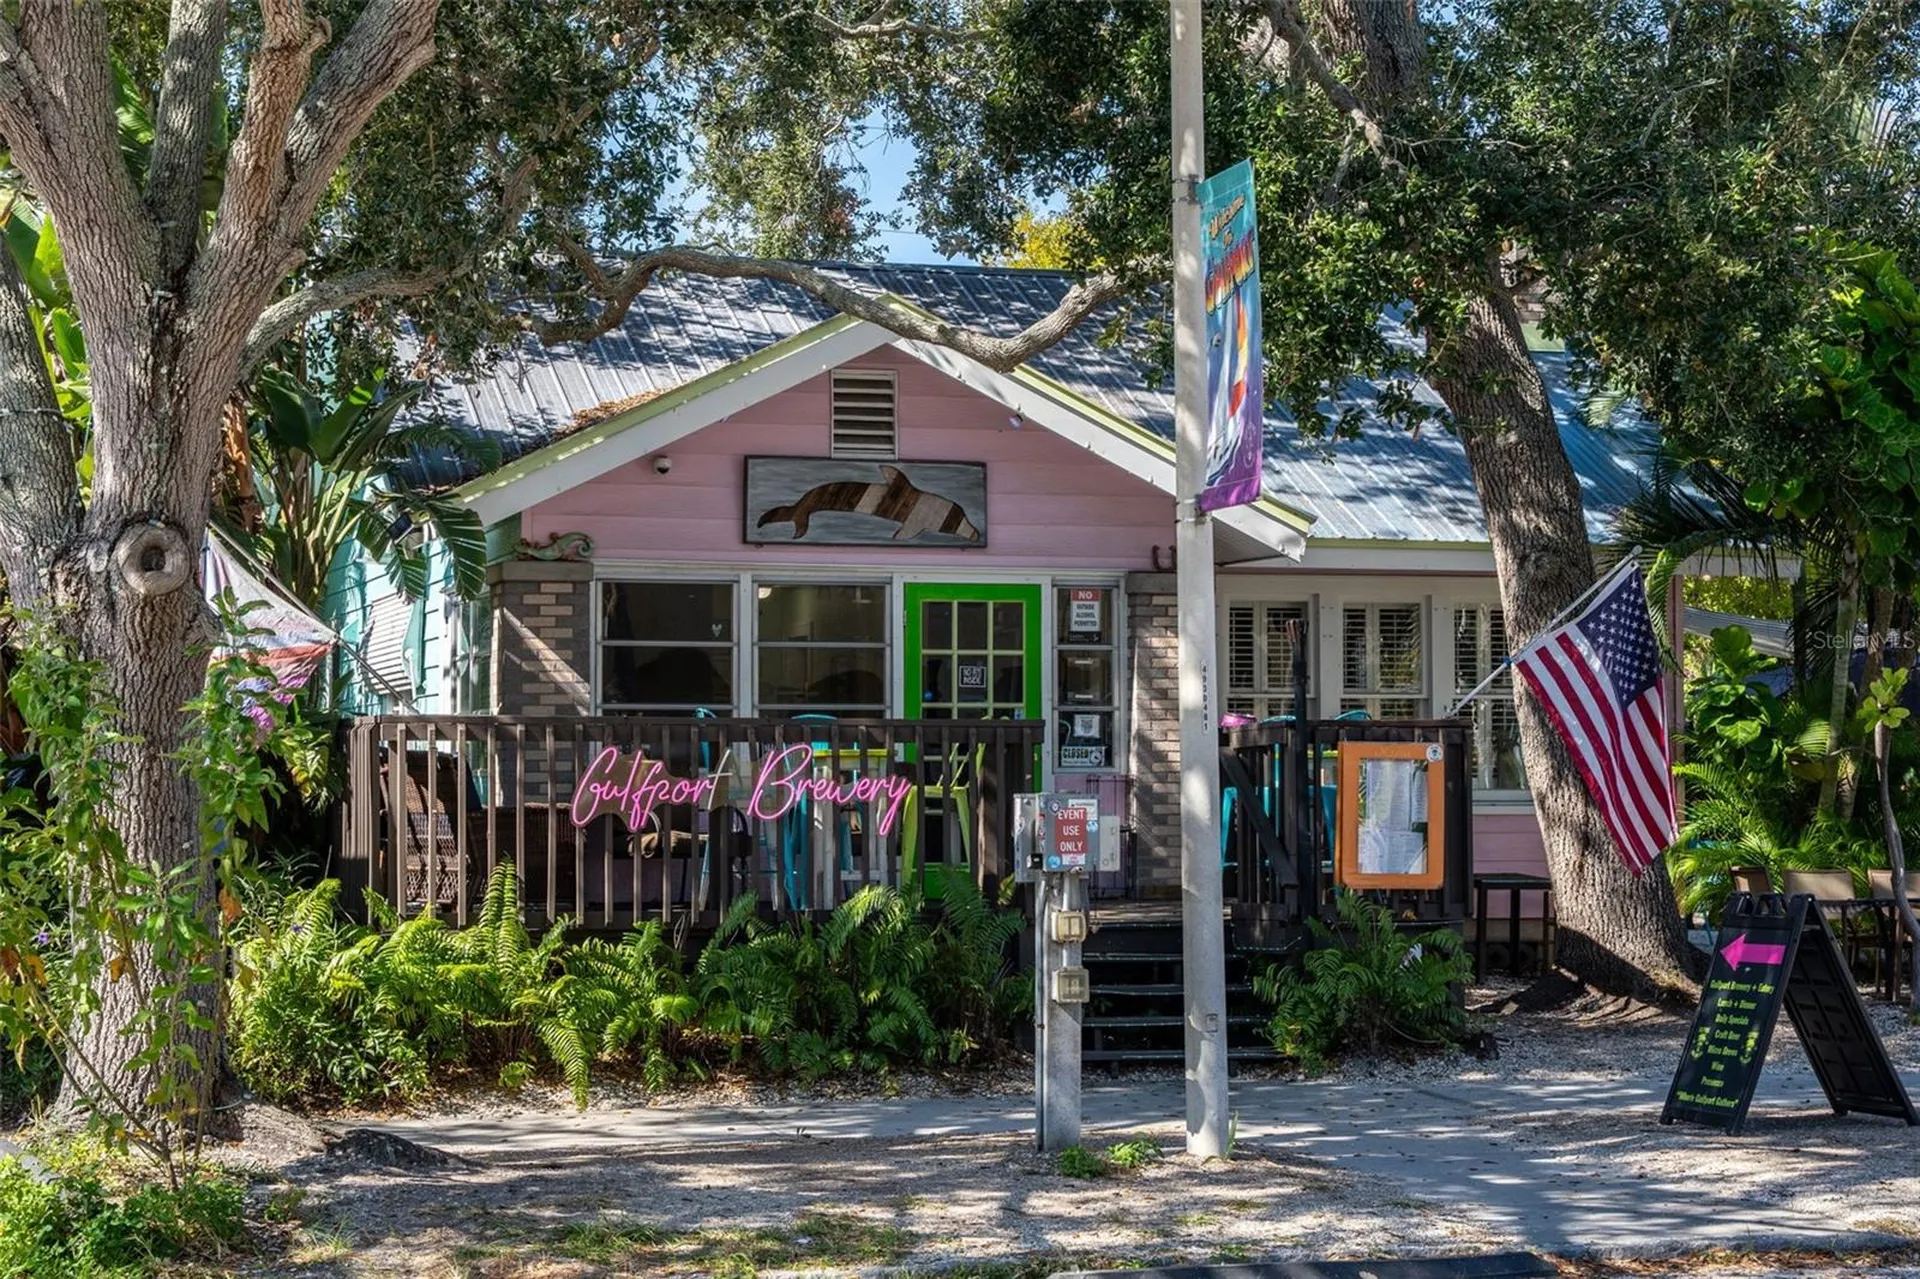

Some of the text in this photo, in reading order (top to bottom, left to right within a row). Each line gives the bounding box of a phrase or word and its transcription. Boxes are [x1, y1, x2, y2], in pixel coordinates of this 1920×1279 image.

[1078, 590, 1093, 600] NO
[1063, 748, 1089, 759] CLOSED
[571, 743, 912, 836] Gulfport Brewery
[1057, 809, 1085, 820] EVENT
[1062, 824, 1080, 836] USE
[1060, 841, 1084, 852] ONLY
